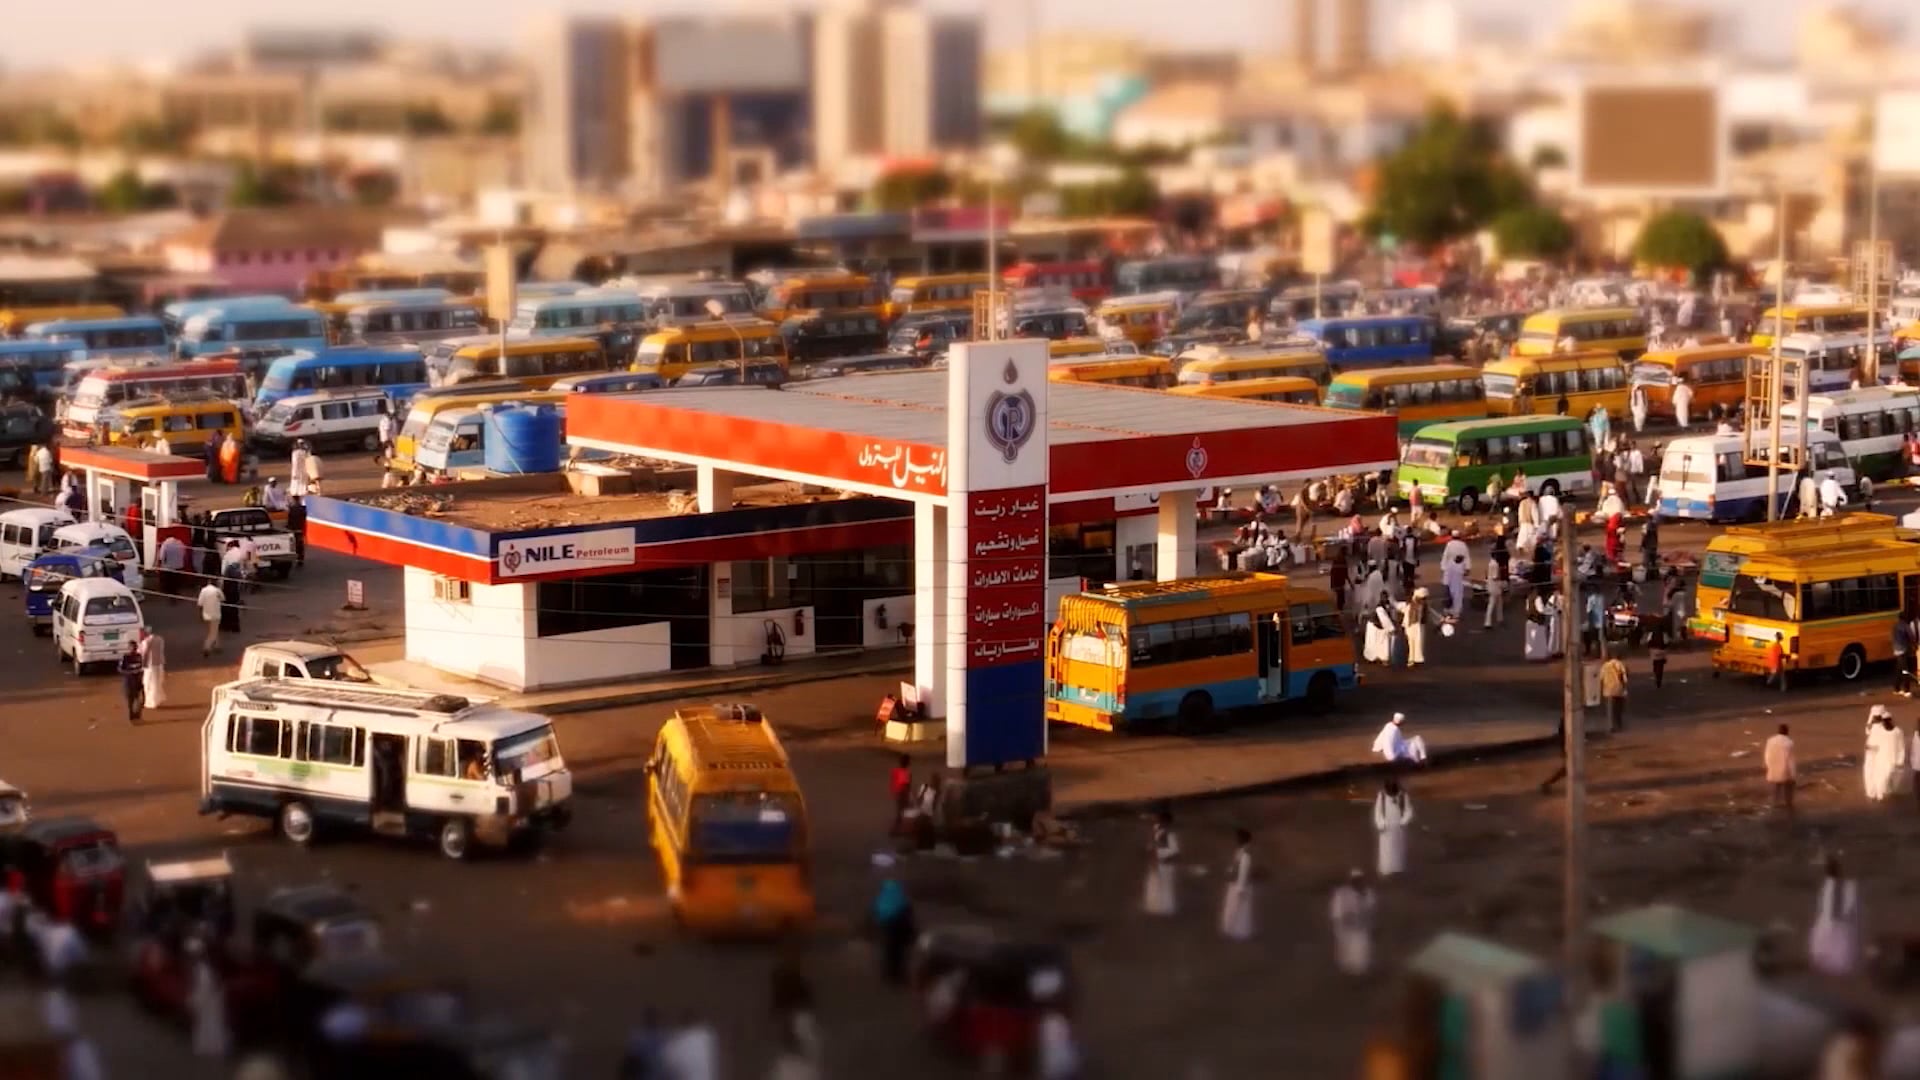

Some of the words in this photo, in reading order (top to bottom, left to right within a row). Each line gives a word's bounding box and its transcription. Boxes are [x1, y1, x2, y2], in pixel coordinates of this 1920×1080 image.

[892, 446, 947, 488] النيل
[974, 496, 1006, 521] زيت
[1007, 493, 1040, 518] غيار
[1015, 528, 1040, 551] غسيل
[525, 544, 575, 563] NILE
[576, 546, 630, 558] Petroleum
[1013, 562, 1039, 582] خدمات
[974, 605, 1001, 627] سيارات
[974, 637, 1040, 662] بطاريات
